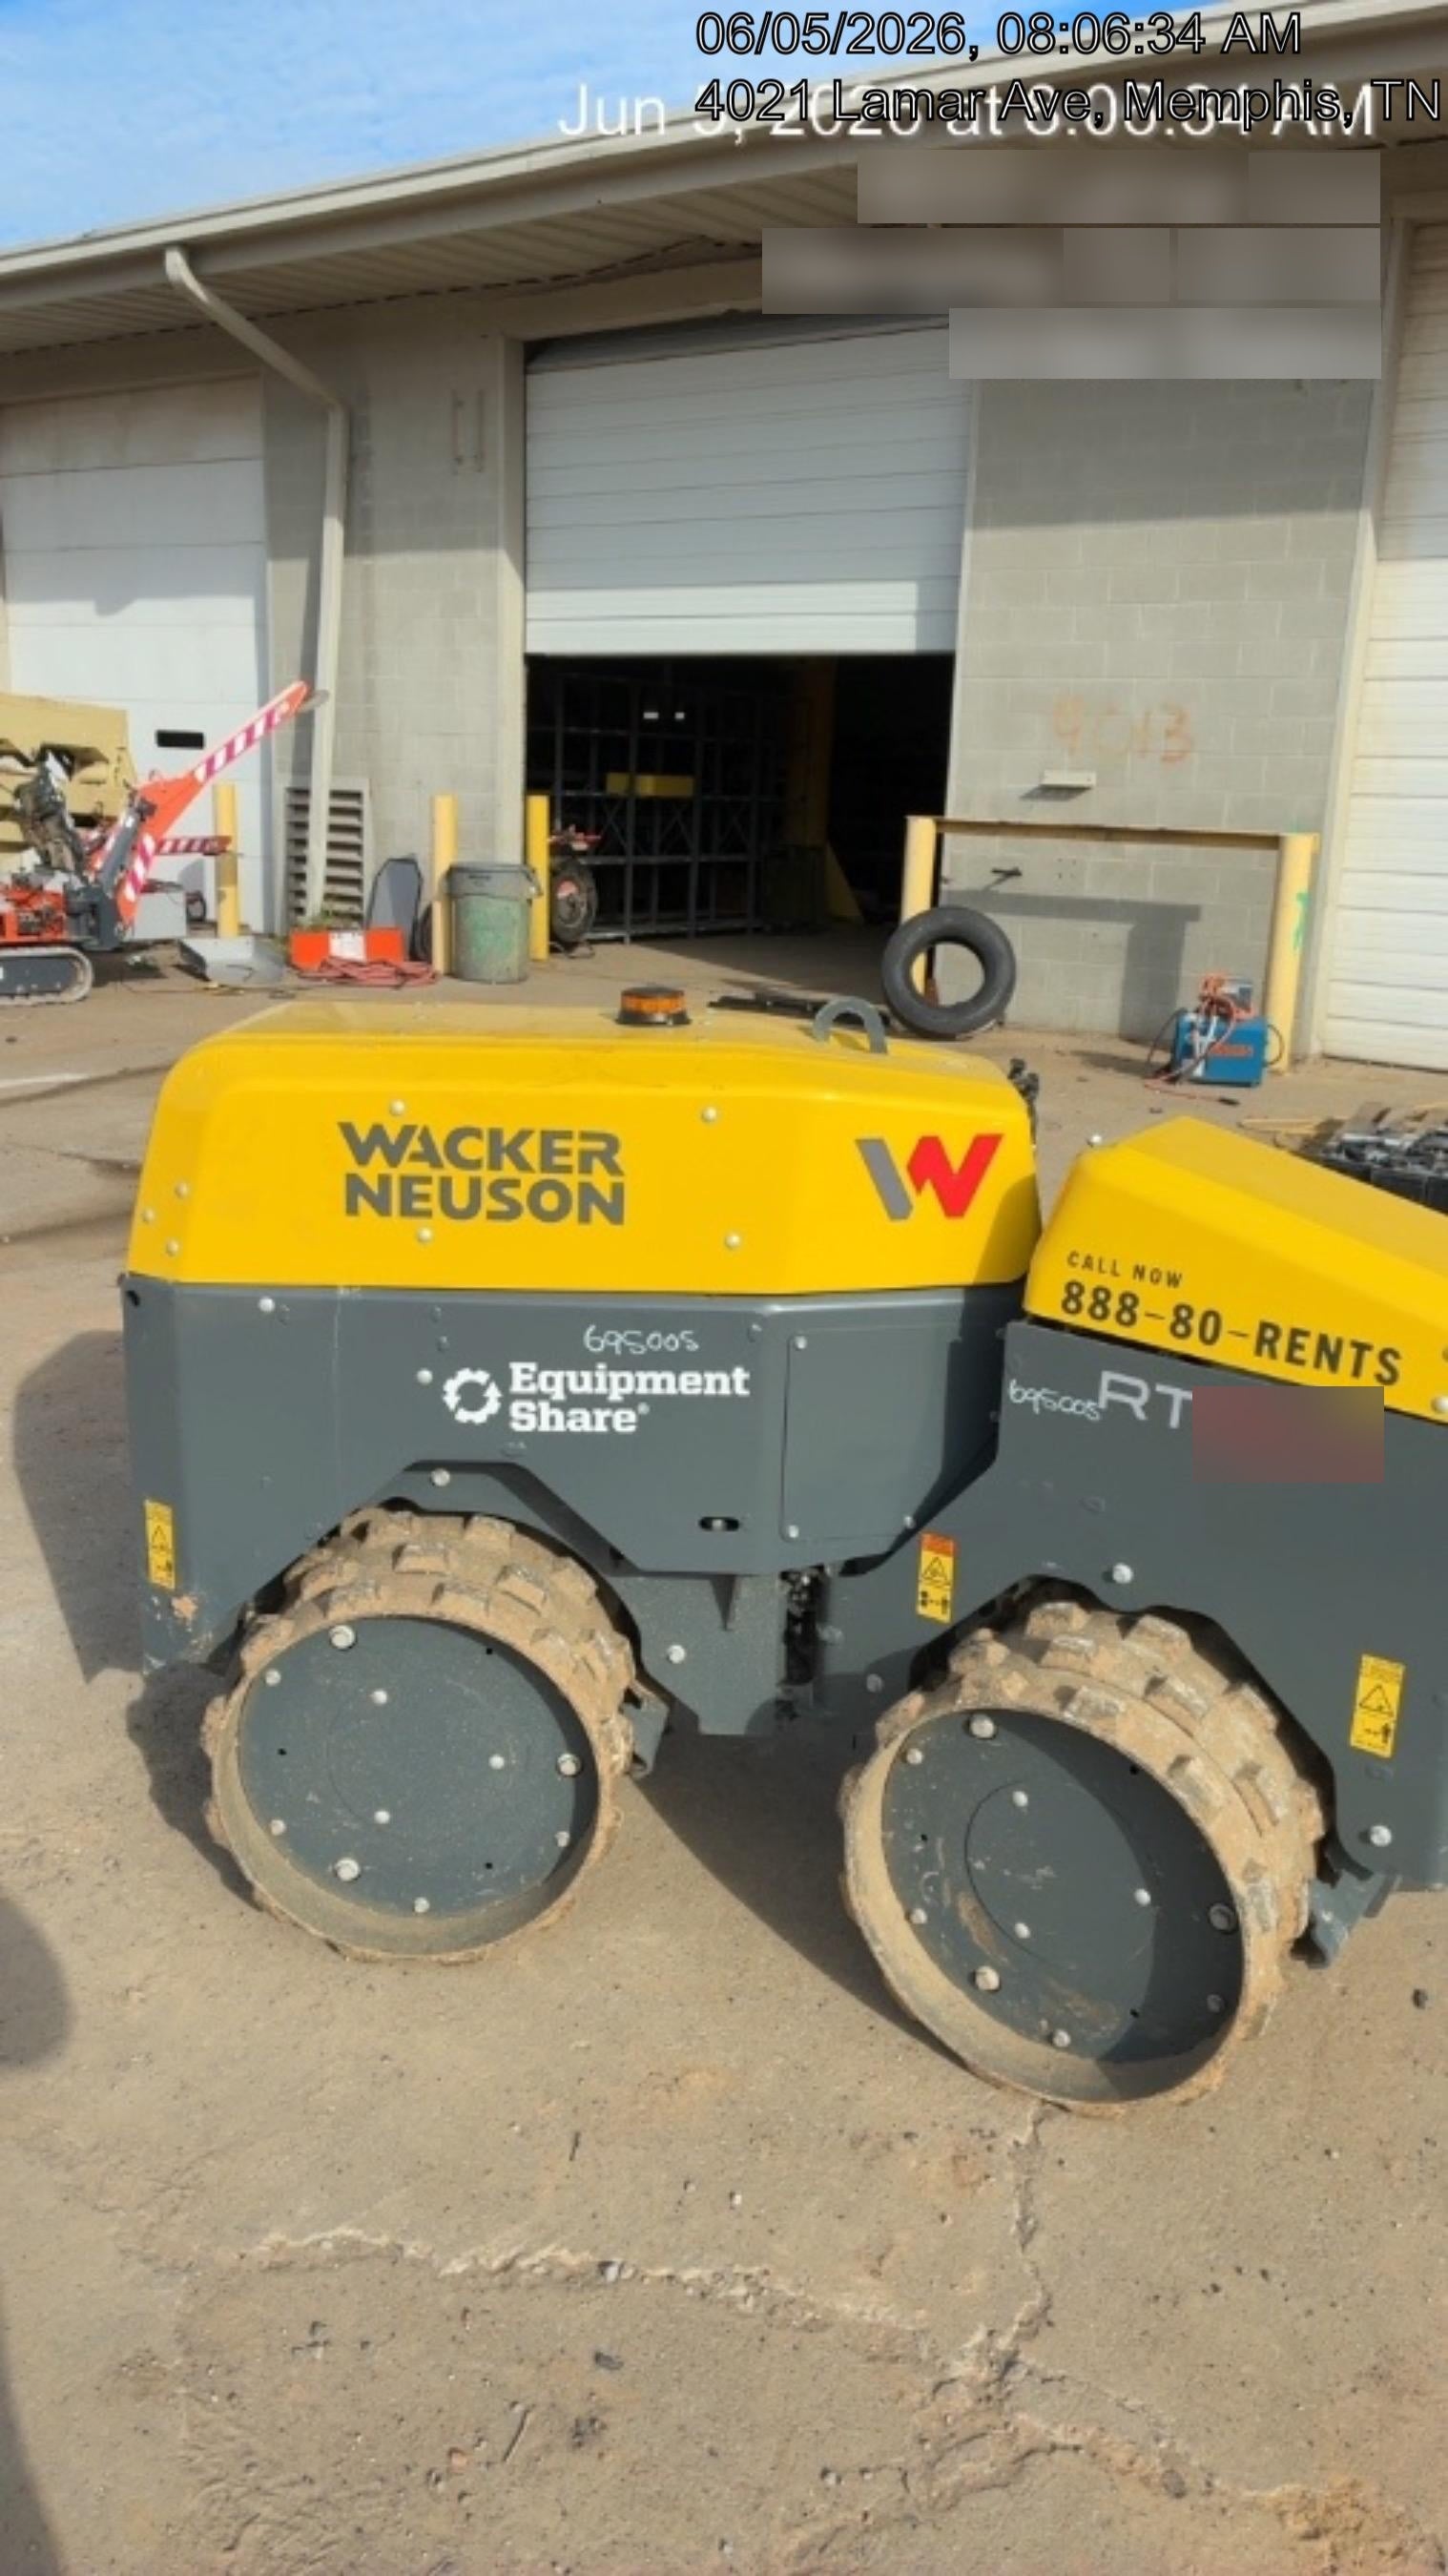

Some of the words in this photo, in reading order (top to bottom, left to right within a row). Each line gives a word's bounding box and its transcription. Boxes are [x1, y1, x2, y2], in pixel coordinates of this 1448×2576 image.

[338, 1122, 625, 1176] WACKER
[345, 1174, 625, 1225] NEUSON
[1066, 1251, 1122, 1278] CALL
[1132, 1264, 1184, 1289] NOW
[1061, 1280, 1403, 1386] 888-80-RENTS
[509, 1361, 751, 1402] Equipment
